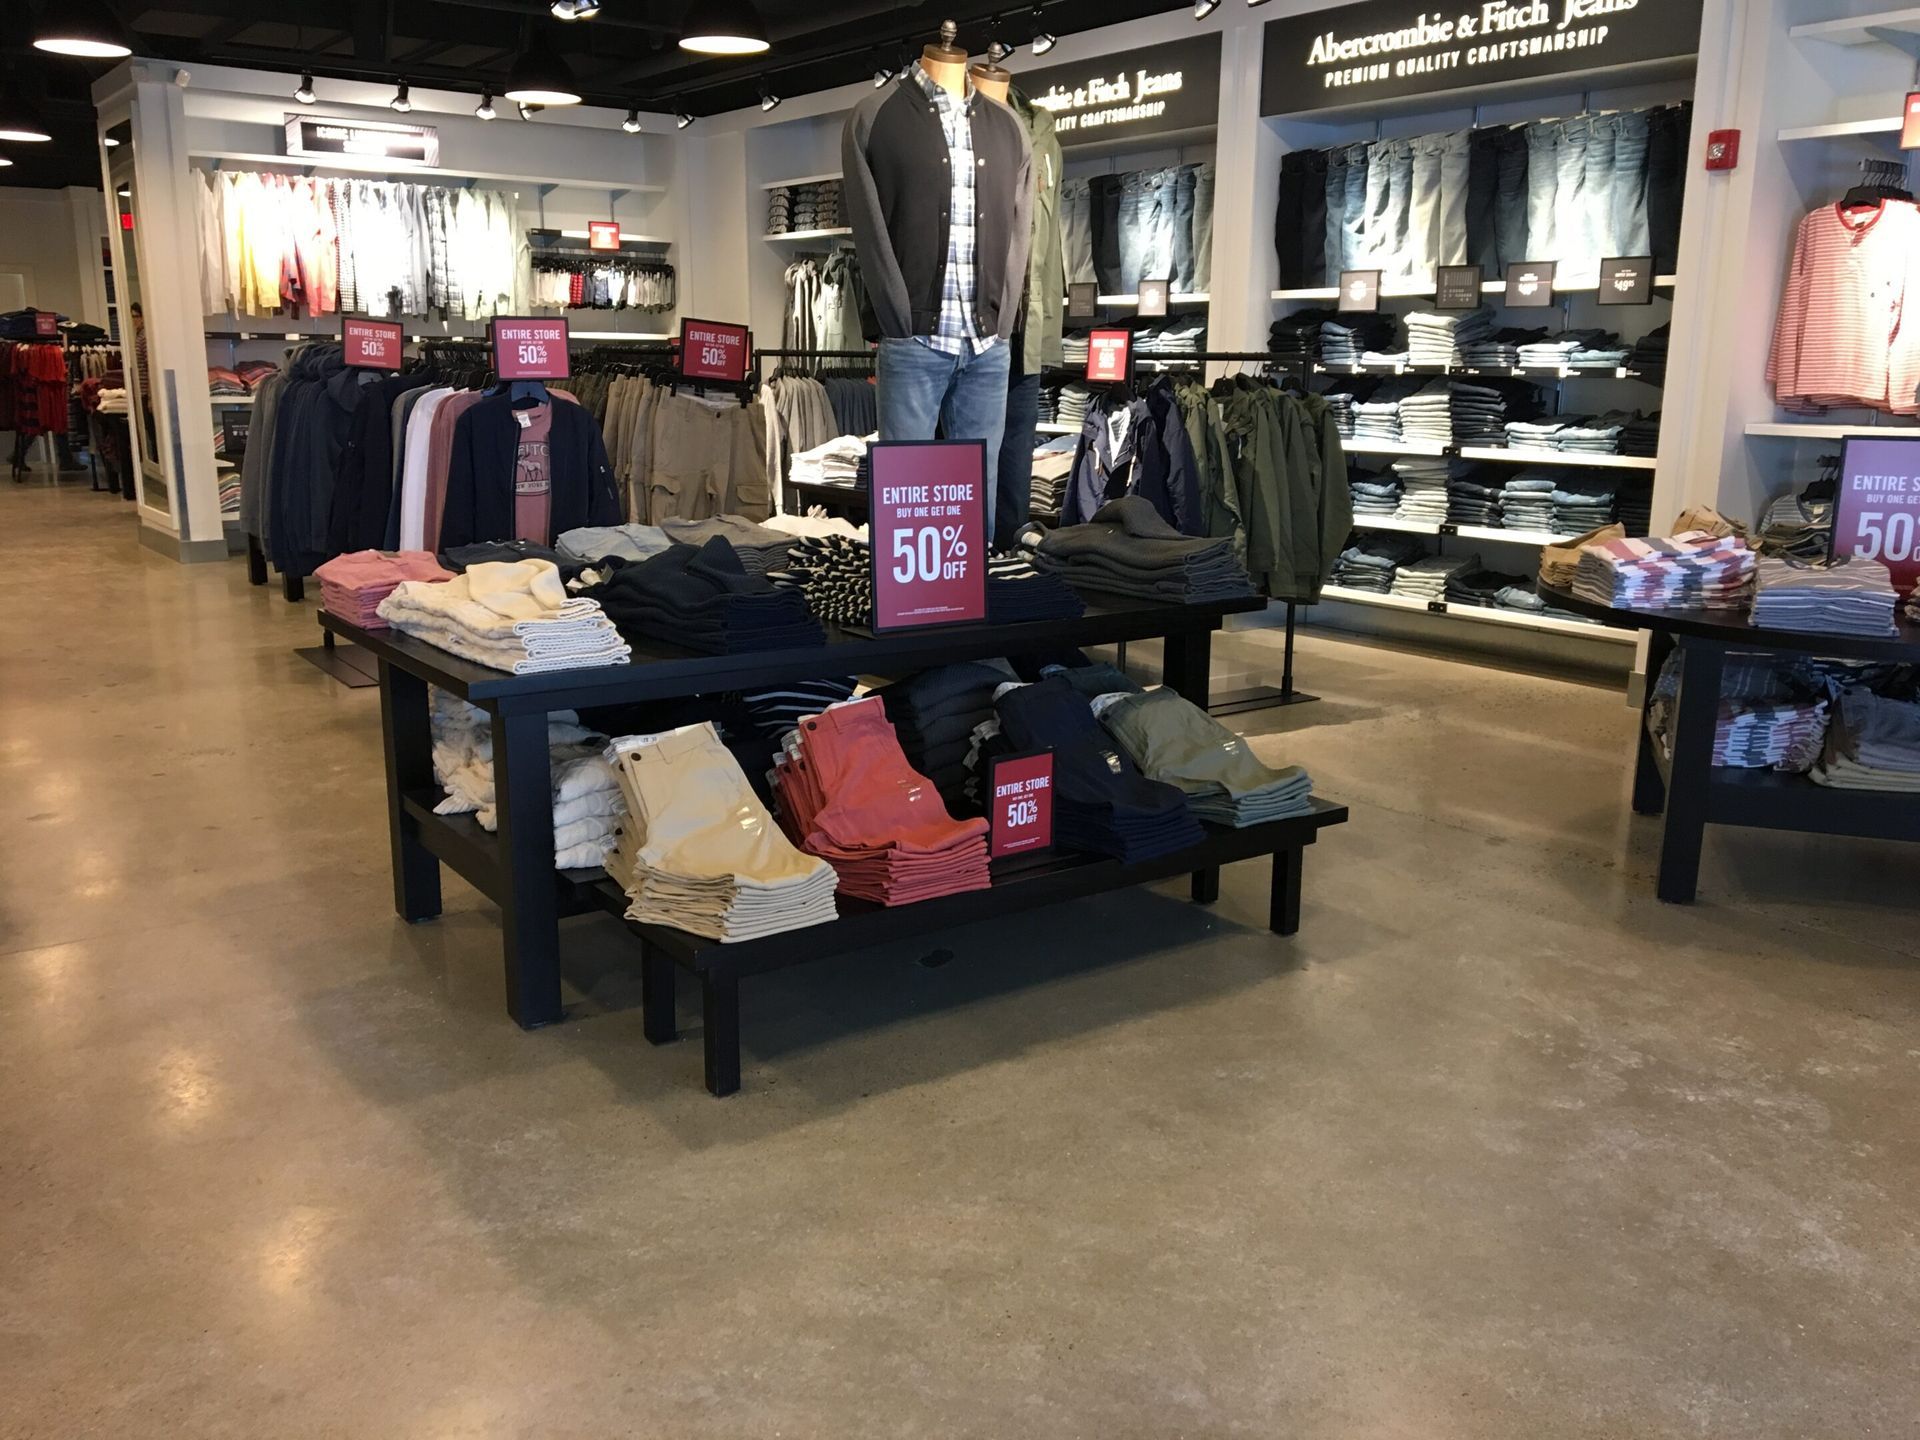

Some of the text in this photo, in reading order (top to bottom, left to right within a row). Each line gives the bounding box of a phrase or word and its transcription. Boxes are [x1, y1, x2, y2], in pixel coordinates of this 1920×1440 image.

[1306, 13, 1454, 65] Abercrombie
[1456, 14, 1478, 39] &
[1480, 0, 1550, 34] Fitch
[1325, 26, 1609, 88] PREMIUM QUALITY CRAFTSMANSHIP
[1088, 72, 1130, 104] Fitch
[1133, 69, 1183, 104] Jeans
[1056, 100, 1166, 132] LITY CRAFTSMANSHIP
[349, 327, 396, 340] ENTIRE STORE
[501, 329, 561, 340] ENTIRE STORE
[689, 330, 716, 343] ENTIRE
[717, 333, 740, 346] STORE
[361, 340, 385, 356] 50%
[518, 345, 548, 365] 50%
[701, 347, 727, 366] 50%
[1853, 475, 1907, 491] ENTIRE
[883, 484, 974, 504] ENTIRE STORE
[1866, 494, 1920, 505] BUY ONE GE
[896, 505, 961, 518] BUY ONE GET ONE
[1854, 511, 1920, 562] 50
[893, 525, 967, 583] 50% OFF
[996, 781, 1024, 797] ENTIRE
[1025, 776, 1050, 791] STORE
[1007, 799, 1038, 828] 50%
